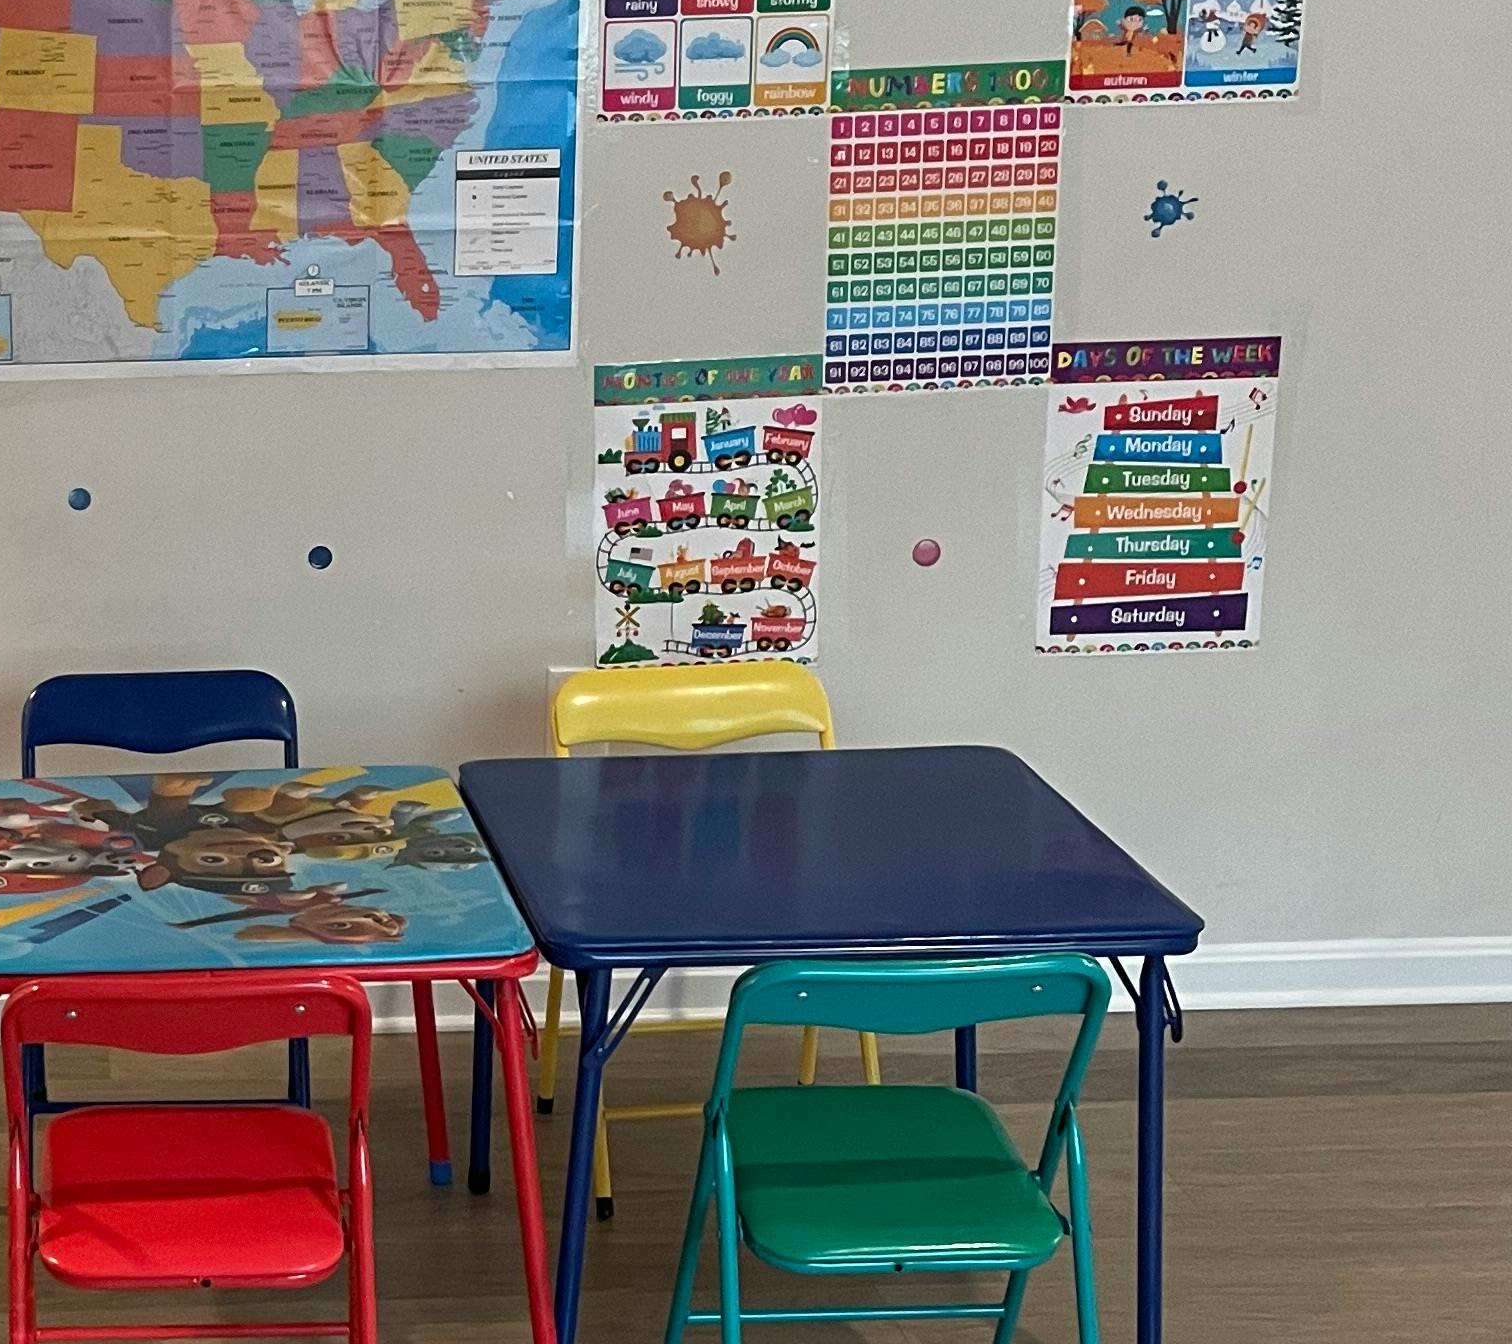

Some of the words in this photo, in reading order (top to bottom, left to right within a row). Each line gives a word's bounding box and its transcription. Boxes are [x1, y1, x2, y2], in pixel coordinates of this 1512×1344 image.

[626, 0, 657, 13] rainy
[848, 71, 978, 98] NUMBERS
[1103, 76, 1147, 86] autumn
[1223, 71, 1258, 83] winter
[620, 91, 659, 105] windy
[697, 89, 733, 104] foggy
[764, 86, 816, 99] rainbow
[861, 121, 870, 132] 2
[884, 120, 893, 131] 3
[907, 119, 915, 130] 4
[930, 118, 939, 129] 5
[954, 117, 962, 128] 6
[976, 116, 984, 127] 7
[1000, 115, 1008, 126] 8
[1022, 114, 1031, 125] 9
[1044, 112, 1056, 123] 10
[859, 149, 871, 160] 12
[882, 147, 894, 159] 13
[905, 146, 916, 158] 14
[928, 145, 940, 157] 15
[951, 144, 963, 156] 16
[975, 144, 986, 155] 17
[997, 143, 1009, 154] 18
[1020, 141, 1032, 152] 19
[1040, 140, 1057, 152] 20
[469, 155, 508, 164] UNITED
[510, 154, 549, 163] STATES
[833, 260, 845, 270] 51
[876, 257, 892, 268] 53
[899, 256, 915, 268] 54
[922, 255, 937, 266] 55
[945, 254, 960, 265] 56
[968, 253, 983, 264] 57
[1013, 251, 1029, 262] 59
[832, 314, 843, 324] 71
[853, 313, 867, 323] 72
[876, 311, 890, 323] 73
[898, 311, 912, 322] 74
[921, 309, 935, 320] 75
[944, 308, 958, 319] 76
[967, 307, 981, 318] 77
[1012, 305, 1026, 316] 79
[1057, 349, 1116, 368] DAYS
[1126, 346, 1154, 365] OF
[1162, 346, 1203, 365] THE
[1212, 344, 1273, 363] WEEK
[695, 367, 718, 386] OF
[769, 363, 814, 381] YEAR
[830, 367, 841, 378] 91
[850, 366, 866, 377] 92
[873, 365, 889, 376] 93
[896, 364, 911, 375] 94
[918, 363, 934, 374] 95
[941, 362, 956, 373] 96
[964, 361, 978, 371] 97
[986, 360, 1002, 371] 98
[1009, 359, 1024, 370] 99
[1030, 357, 1049, 368] 100
[1129, 407, 1192, 423] Sunday
[711, 437, 749, 450] January
[765, 432, 809, 449] February
[1125, 438, 1192, 455] Monday
[1123, 471, 1190, 488] Tuesday
[672, 501, 694, 513] May
[724, 499, 745, 512] April
[774, 495, 806, 512] March
[617, 507, 639, 519] June
[1107, 504, 1202, 521] Wednesday
[1116, 537, 1190, 554] Thursday
[618, 567, 636, 582] July
[666, 567, 699, 580] August
[712, 564, 764, 576] September
[773, 561, 812, 576] October
[1125, 570, 1176, 588] Friday
[1111, 608, 1185, 626] Saturday
[694, 629, 743, 641] December
[753, 623, 803, 634] November
